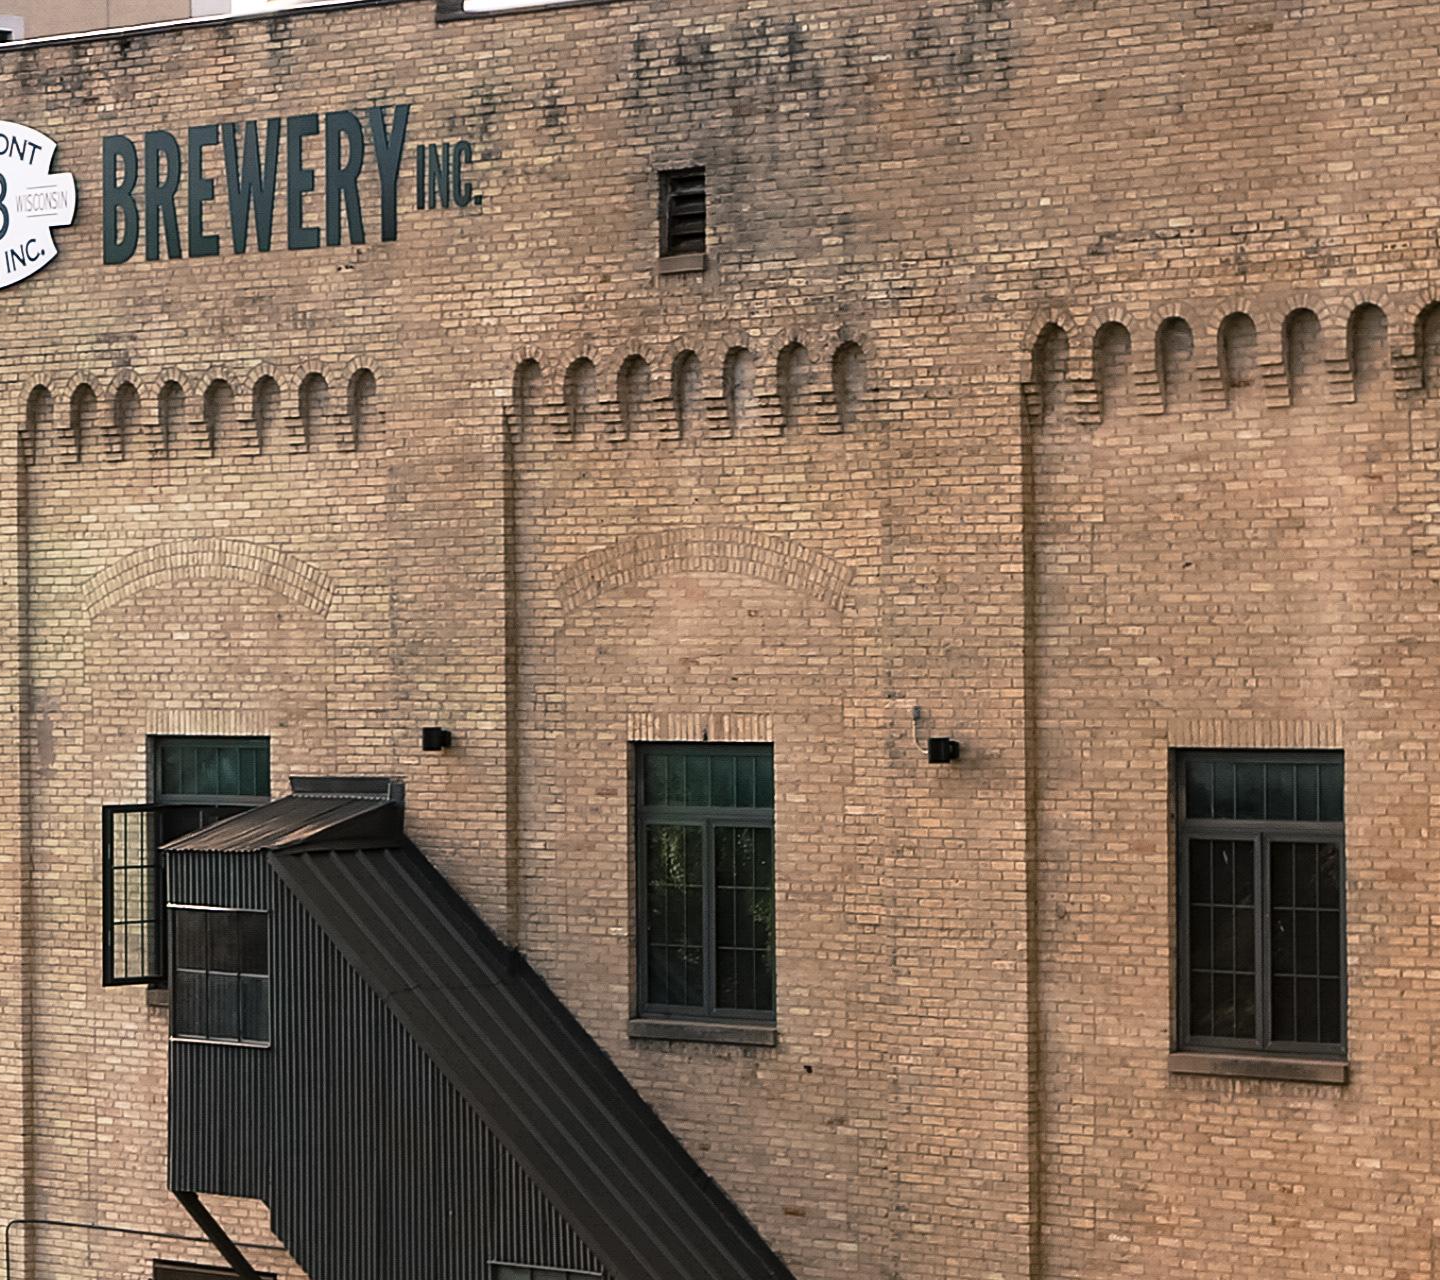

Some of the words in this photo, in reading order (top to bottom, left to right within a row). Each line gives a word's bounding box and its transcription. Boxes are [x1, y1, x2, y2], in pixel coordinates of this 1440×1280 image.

[15, 191, 69, 212] WISCONSIN
[103, 104, 411, 265] BREWERY
[417, 141, 483, 210] INC.
[4, 238, 45, 274] INC.
